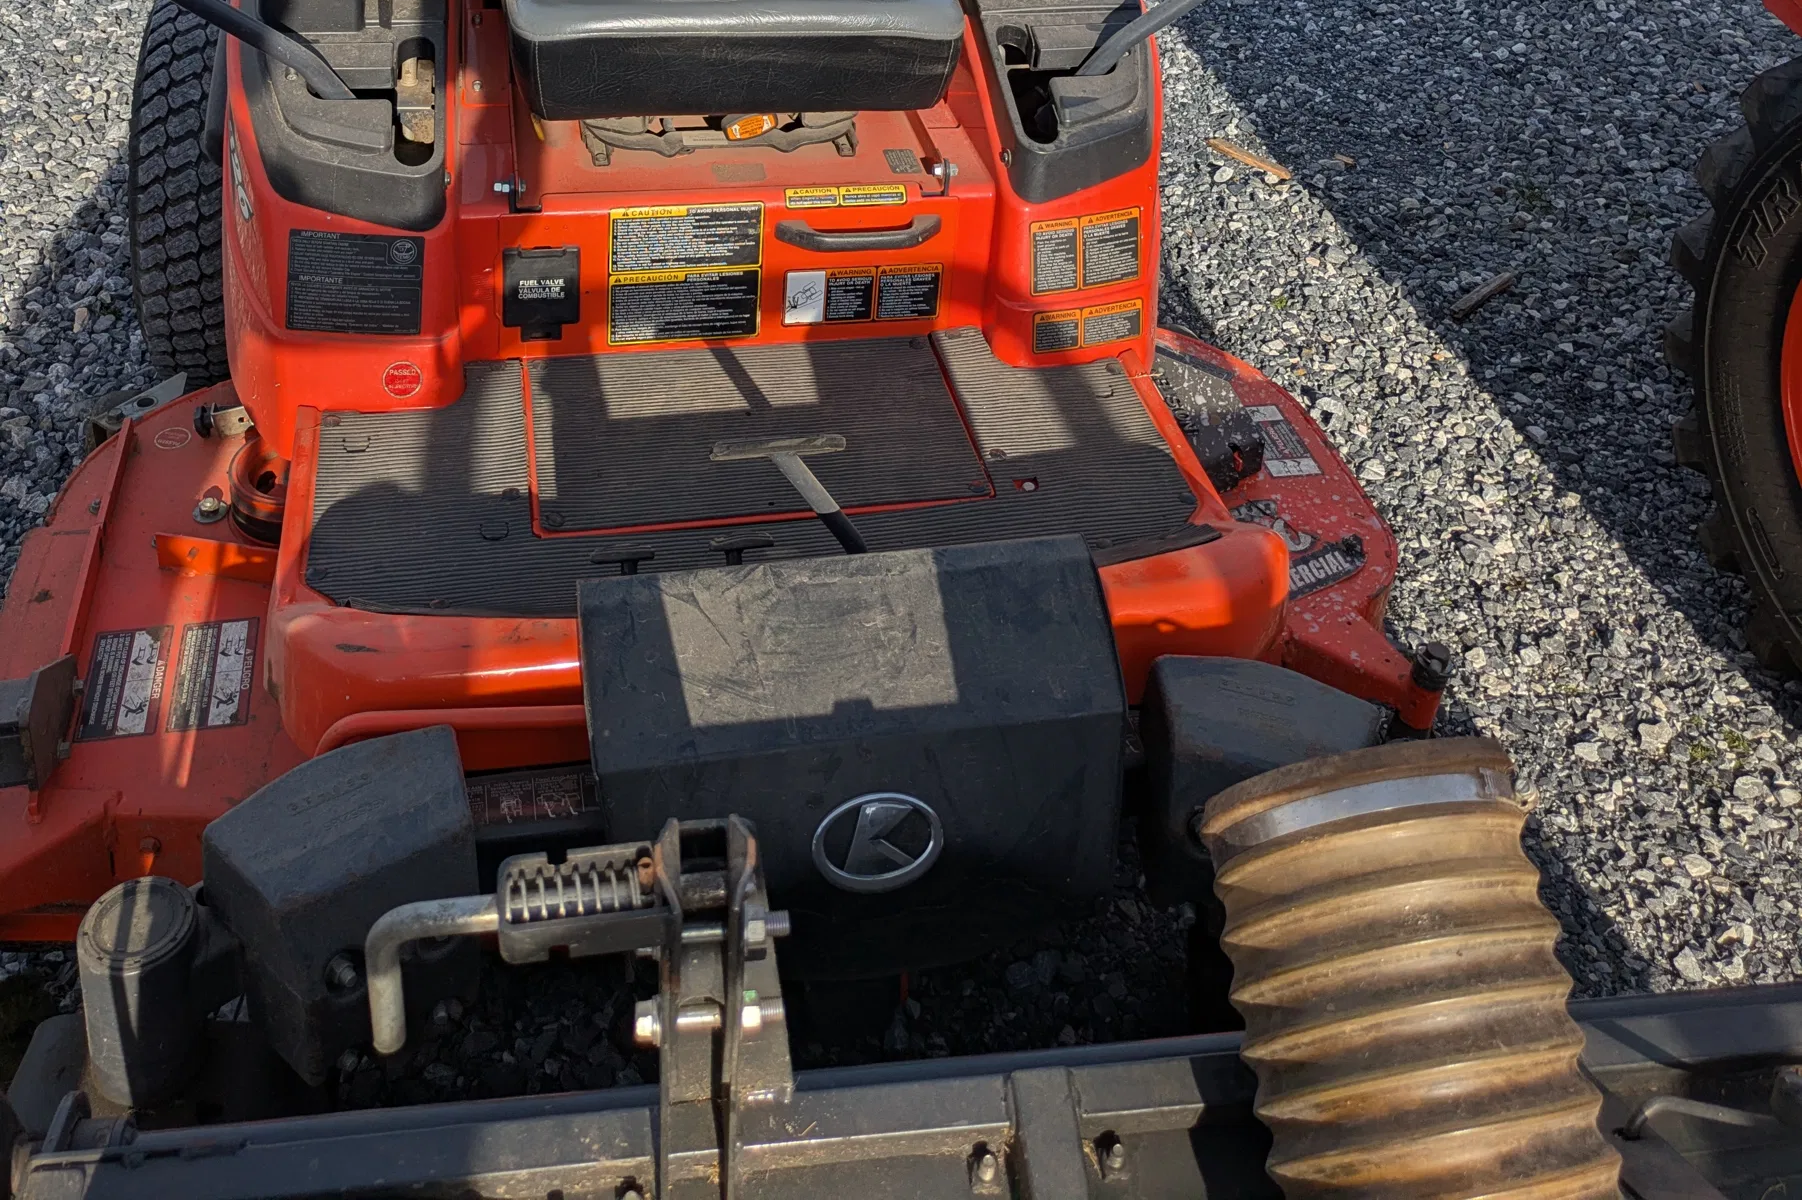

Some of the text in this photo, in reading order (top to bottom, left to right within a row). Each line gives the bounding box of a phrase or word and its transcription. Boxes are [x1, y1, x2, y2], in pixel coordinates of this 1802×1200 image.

[631, 208, 672, 217] CAUTION
[1095, 210, 1132, 221] ADVERTENCIA
[300, 230, 340, 239] IMPORTANT
[888, 265, 939, 273] ADVERTENCIA
[298, 275, 343, 283] IMPORTANTE
[540, 278, 565, 286] VALVE
[623, 273, 679, 282] PRECAUCIÓN
[518, 291, 565, 299] COMBUSTIBLE
[1093, 302, 1136, 313] ADVERTENCIA
[1045, 311, 1076, 321] WARNING
[240, 655, 253, 690] PELIGRO
[150, 666, 164, 699] DANGER
